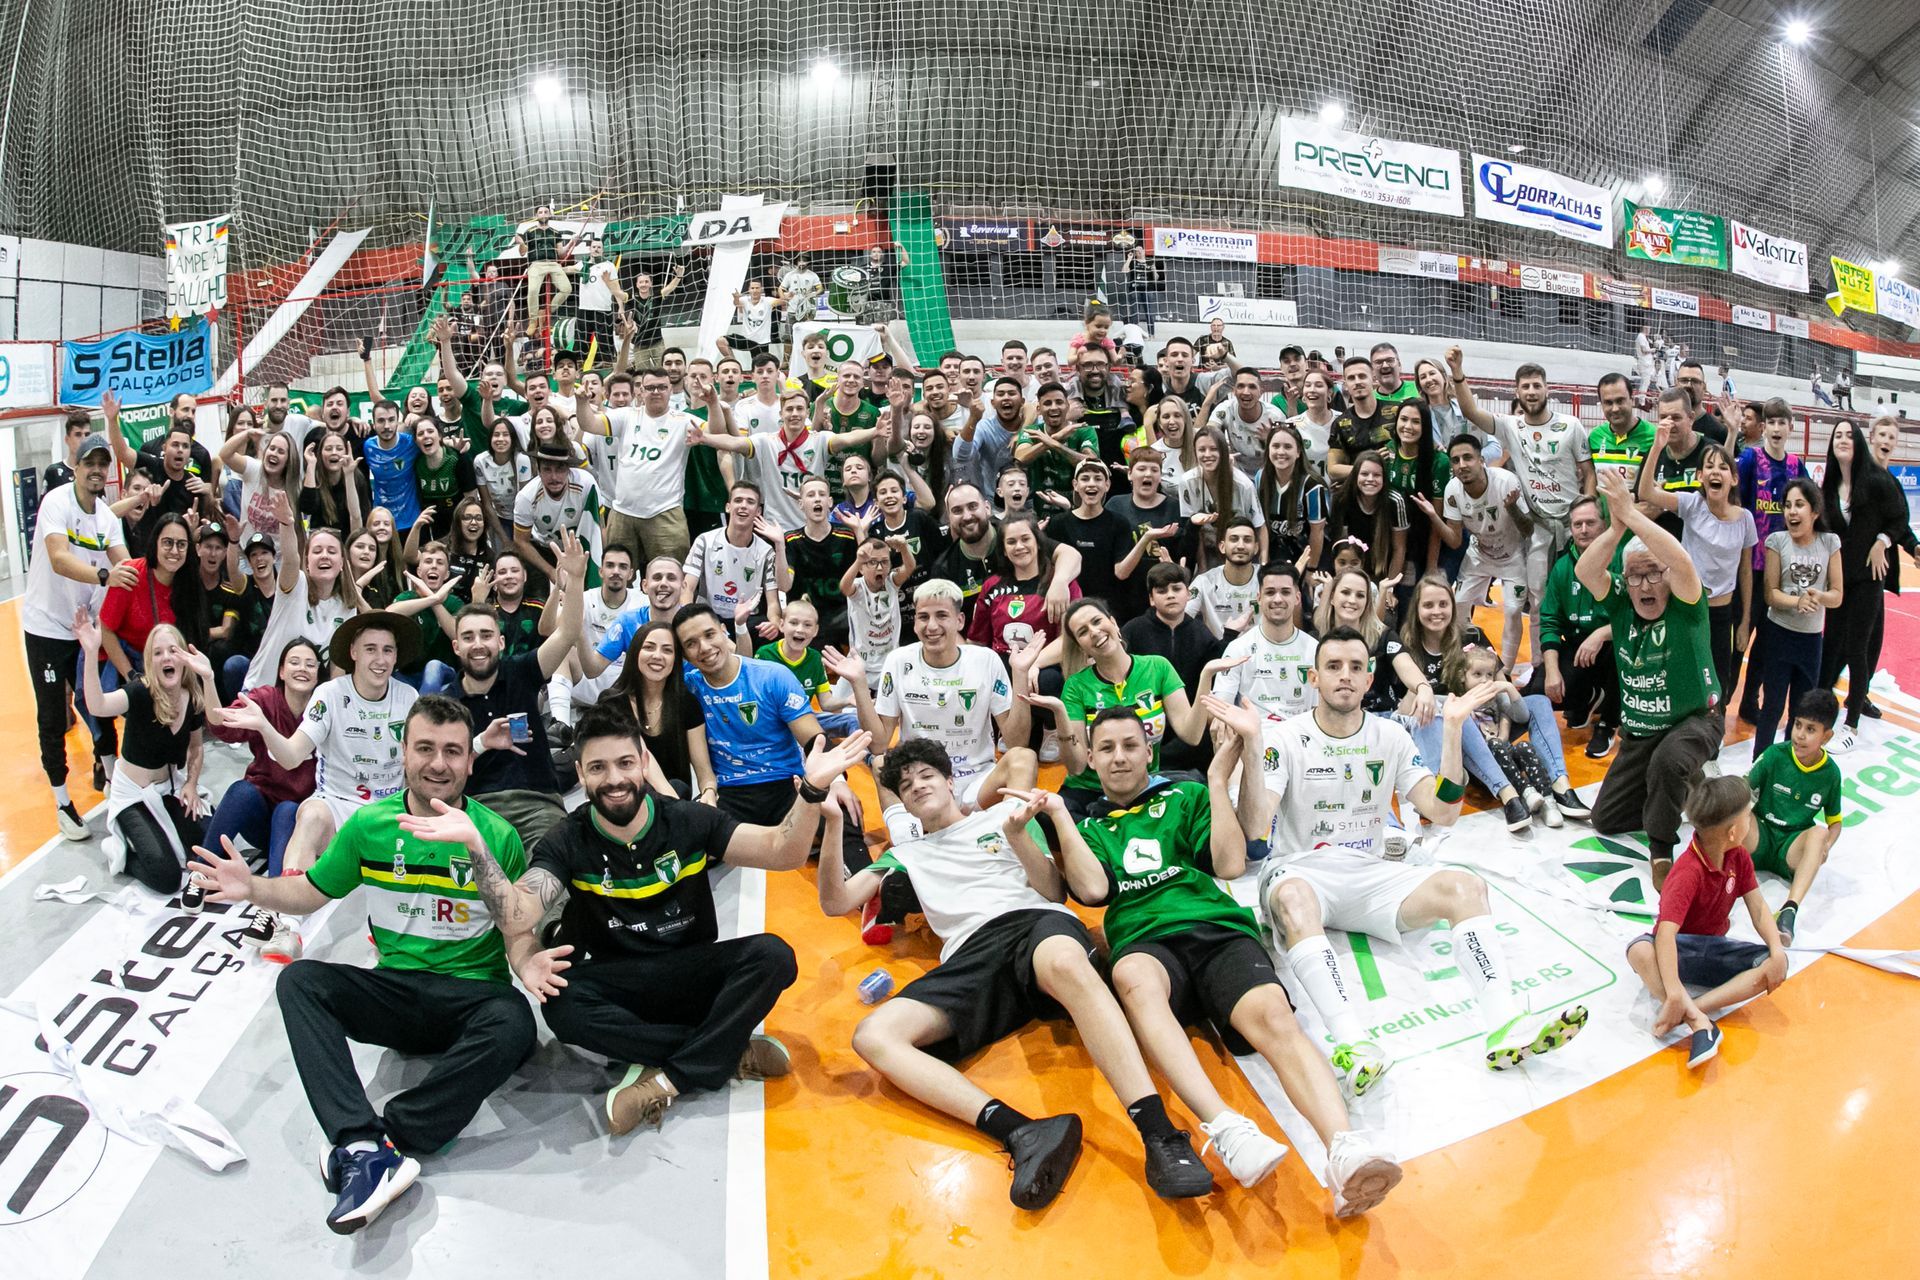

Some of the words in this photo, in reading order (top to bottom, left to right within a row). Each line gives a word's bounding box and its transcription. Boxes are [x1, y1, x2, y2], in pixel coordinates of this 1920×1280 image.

[1295, 141, 1450, 191] PREVENCI
[1479, 161, 1520, 206] CL
[1517, 184, 1602, 220] BORRACHAS
[175, 222, 215, 248] TRI
[970, 224, 1010, 235] Bavarium
[1178, 232, 1253, 246] Petermann
[1746, 231, 1804, 266] Valorize
[1420, 261, 1438, 273] sport
[1439, 263, 1457, 275] mania
[1541, 270, 1558, 281] BOM
[168, 273, 227, 306] GAÚCHO
[1546, 281, 1581, 295] BURGUER
[1655, 296, 1697, 311] BESKOW
[110, 334, 205, 374] Stella
[109, 363, 205, 395] CALÇADOS
[629, 443, 662, 461] T10
[780, 471, 813, 488] T1
[1755, 498, 1783, 514] Raku
[1274, 653, 1301, 662] Sicredi
[44, 669, 56, 683] 99
[932, 678, 964, 687] Sicredi
[1622, 689, 1671, 713] Zaleski
[368, 711, 390, 720] Sicre
[1143, 718, 1164, 737] RS
[943, 738, 978, 748] TILER
[1336, 745, 1369, 756] Sicredi
[373, 770, 402, 780] STILE
[374, 787, 401, 799] SECCH
[1338, 817, 1381, 831] STILER
[1118, 878, 1148, 893] JOHN
[437, 899, 471, 924] RS
[1464, 930, 1498, 983] PROMOSILK
[1322, 948, 1350, 1003] PROMOSILK
[1538, 962, 1574, 982] RS
[35, 898, 230, 1067] Stel
[103, 905, 257, 1076] CALÇA
